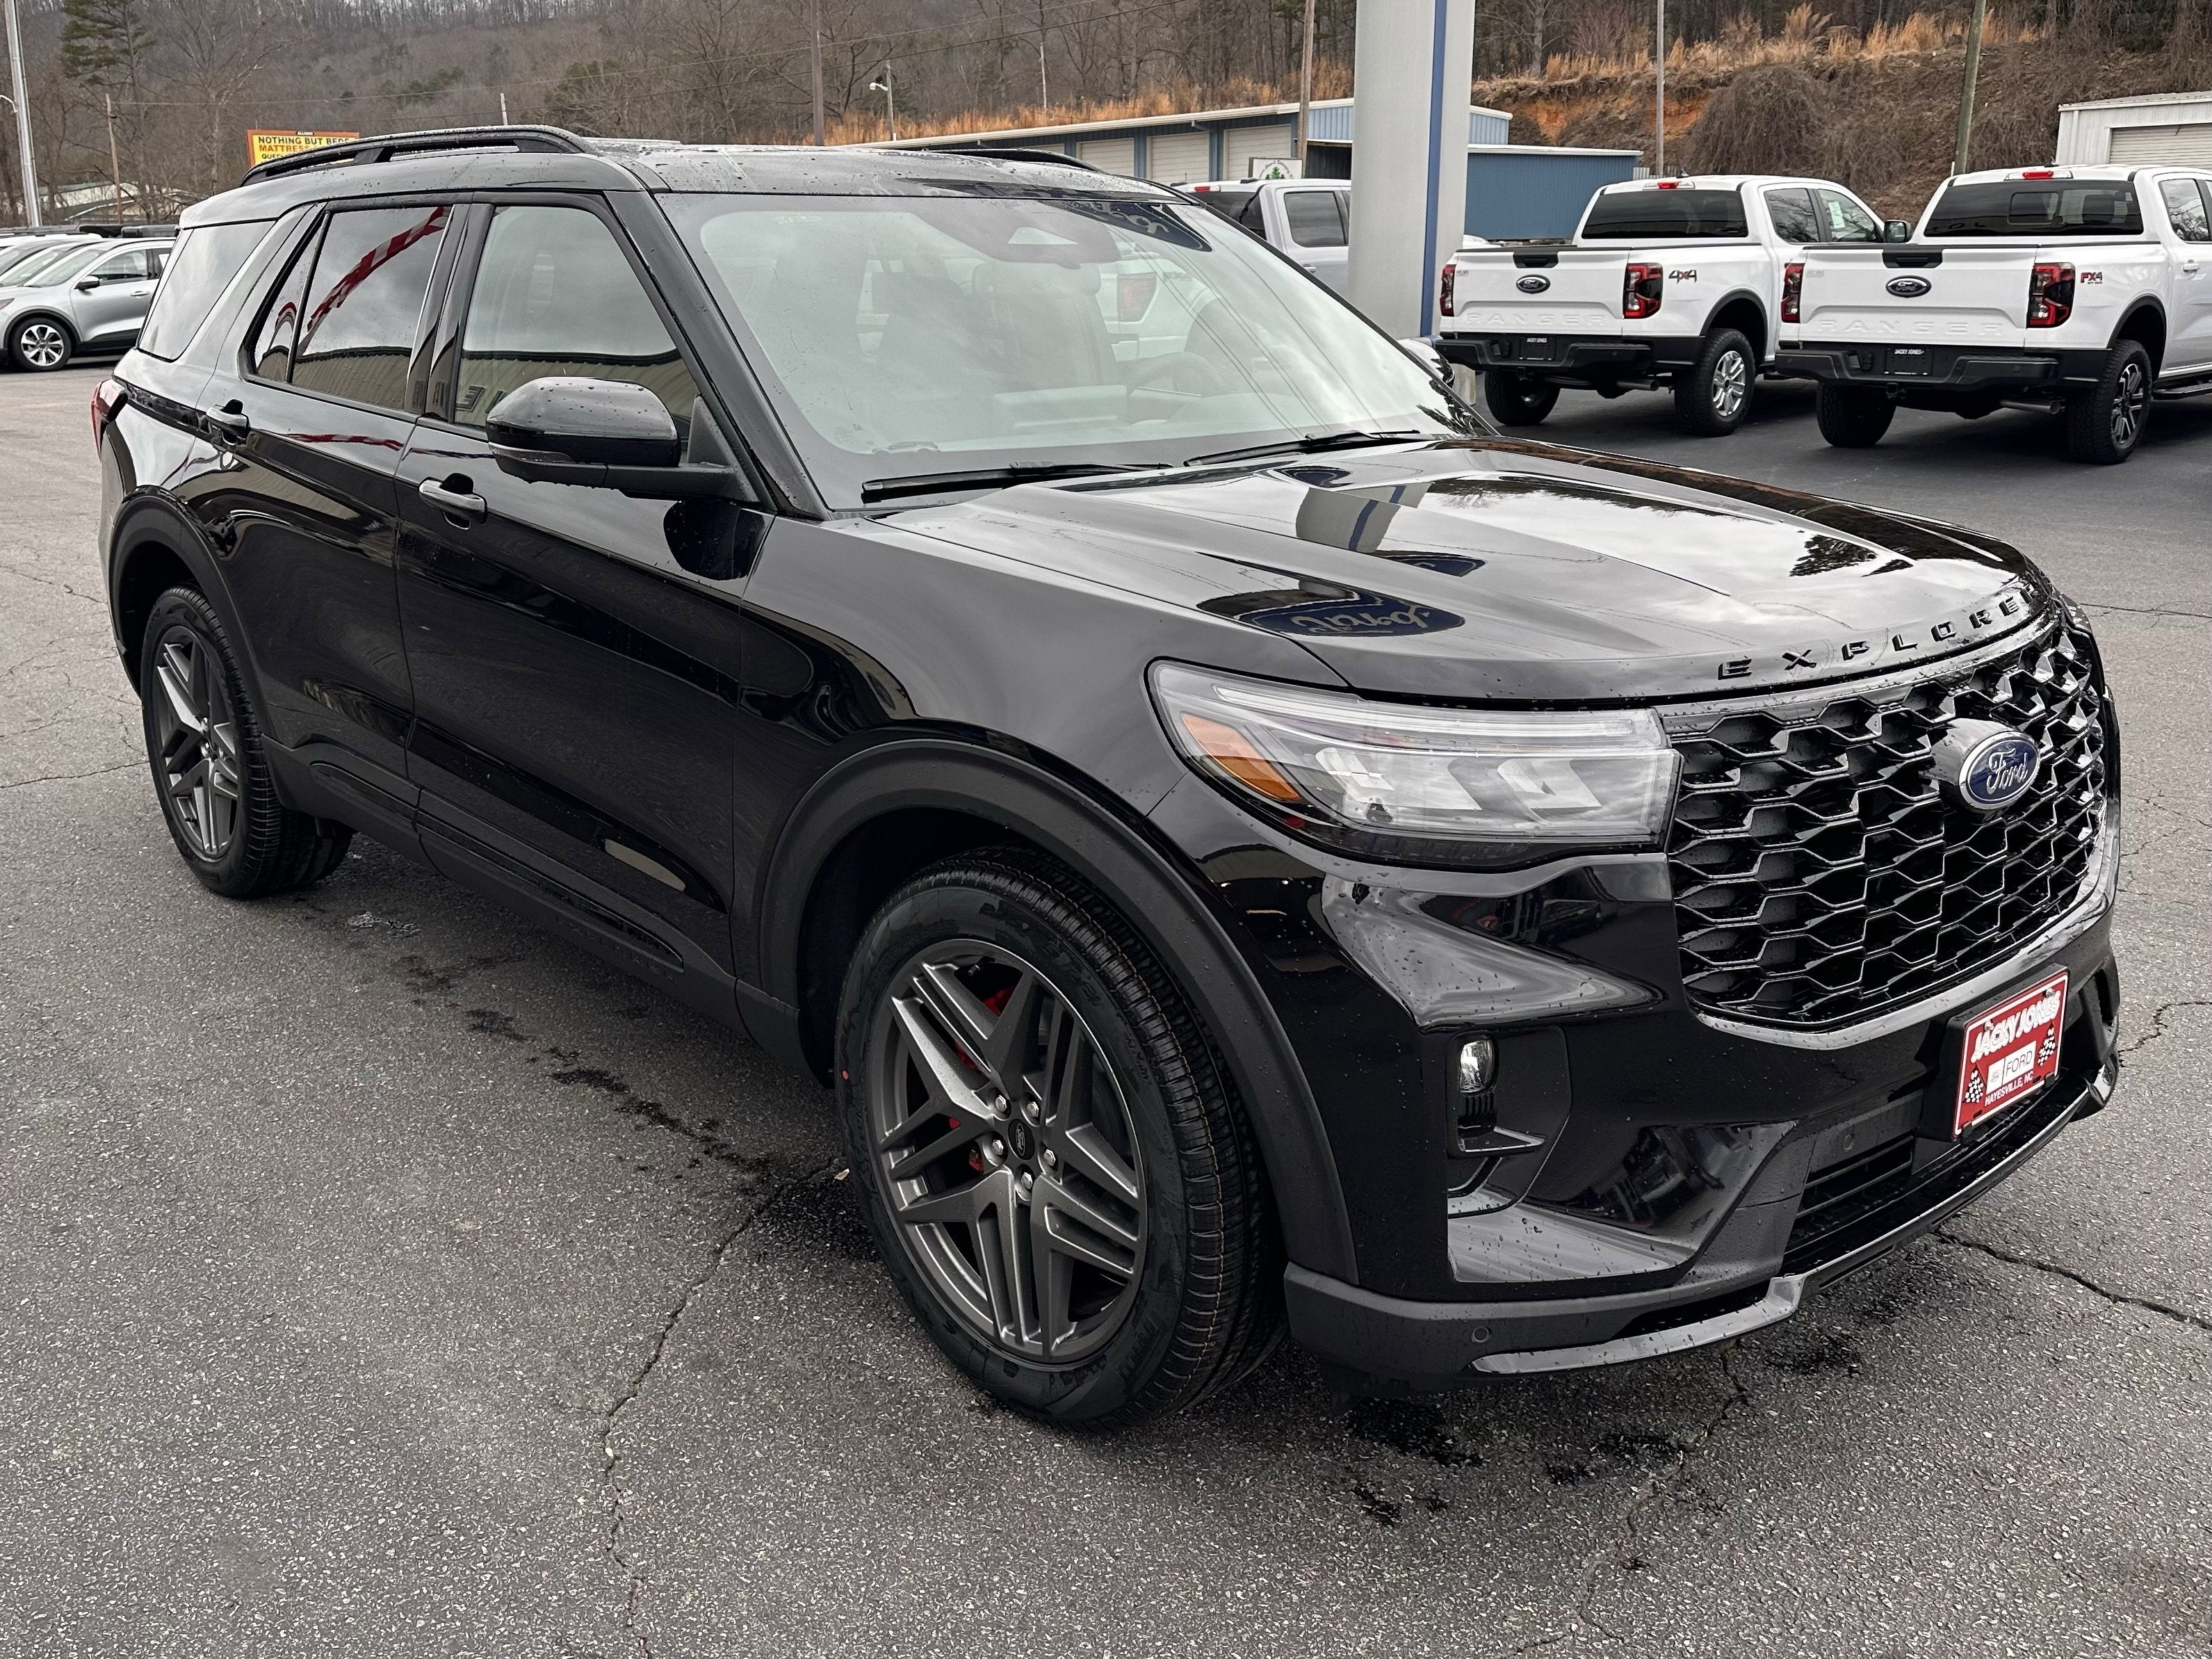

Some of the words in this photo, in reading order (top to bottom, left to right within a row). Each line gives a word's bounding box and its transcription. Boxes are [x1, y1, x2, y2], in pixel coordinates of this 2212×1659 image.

[258, 136, 302, 145] NOTHING
[304, 137, 323, 145] BUT
[2080, 271, 2103, 284] FX4
[1466, 312, 1606, 327] RANGER
[1816, 319, 2003, 337] RANGER
[1718, 583, 2035, 681] EXPLORER
[1986, 747, 2028, 795] Ford
[1971, 1011, 2022, 1064] JACKY
[2016, 990, 2061, 1039] JONES
[2006, 1050, 2033, 1077] FORD
[1985, 1077, 2024, 1107] HAYESVILLE,
[2024, 1071, 2034, 1083] NC
